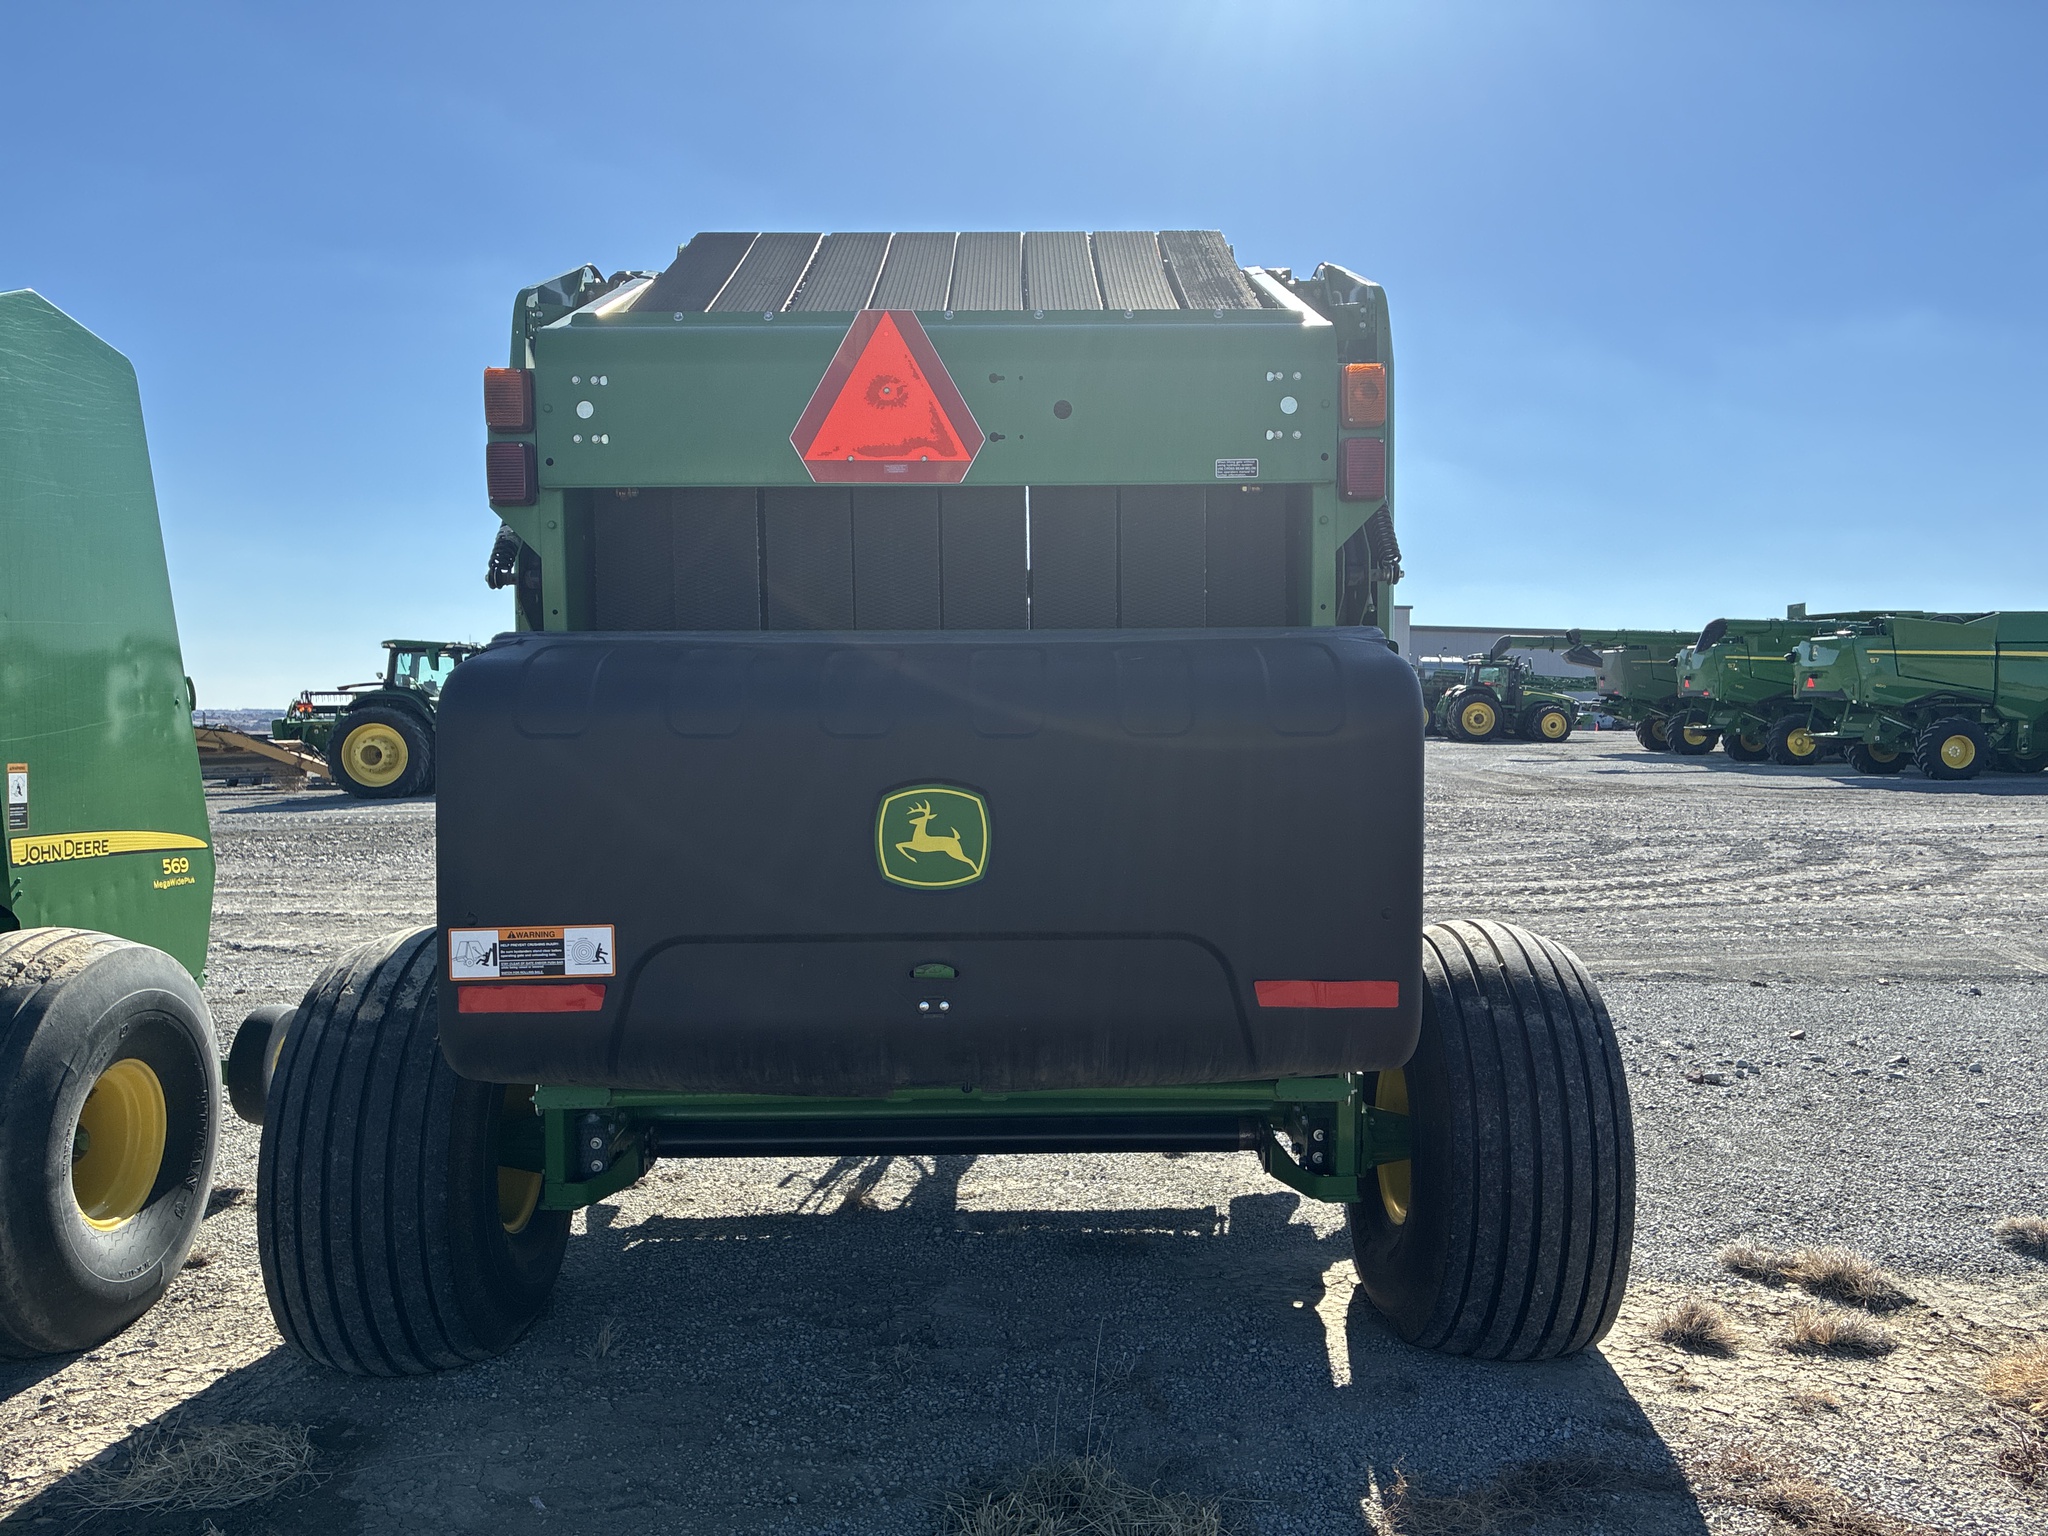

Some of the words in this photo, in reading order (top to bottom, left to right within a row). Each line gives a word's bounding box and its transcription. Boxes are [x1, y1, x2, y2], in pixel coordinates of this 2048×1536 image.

[20, 843, 62, 864] JOHN
[64, 839, 110, 858] DEERE
[162, 856, 189, 875] 569
[516, 930, 556, 938] WARNING
